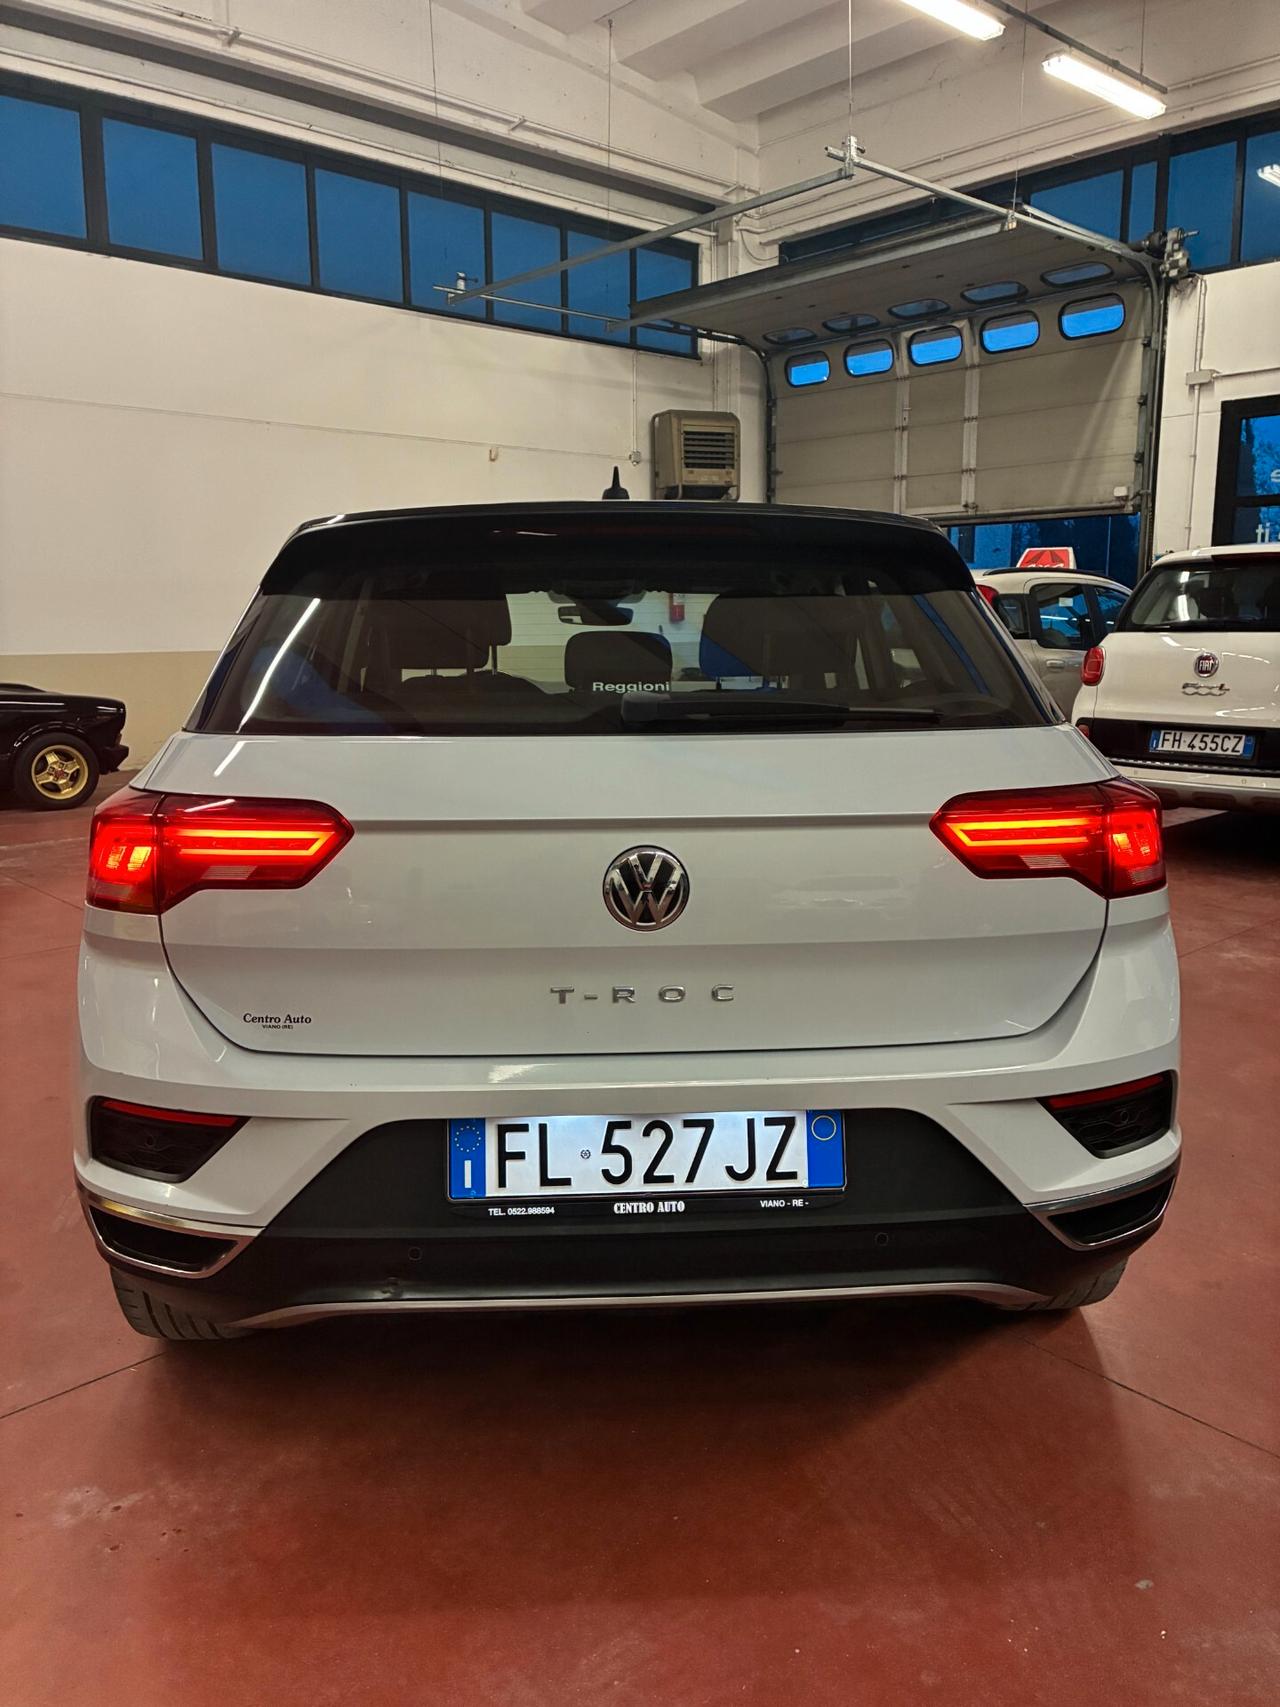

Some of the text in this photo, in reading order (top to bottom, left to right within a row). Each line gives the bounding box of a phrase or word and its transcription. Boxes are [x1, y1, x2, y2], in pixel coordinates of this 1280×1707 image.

[1199, 659, 1213, 672] FIAT
[242, 1012, 312, 1024] Centro Auto
[613, 1200, 686, 1214] CENTRO AUTO
[760, 1199, 786, 1208] VIANO
[488, 1207, 506, 1216] TEL.
